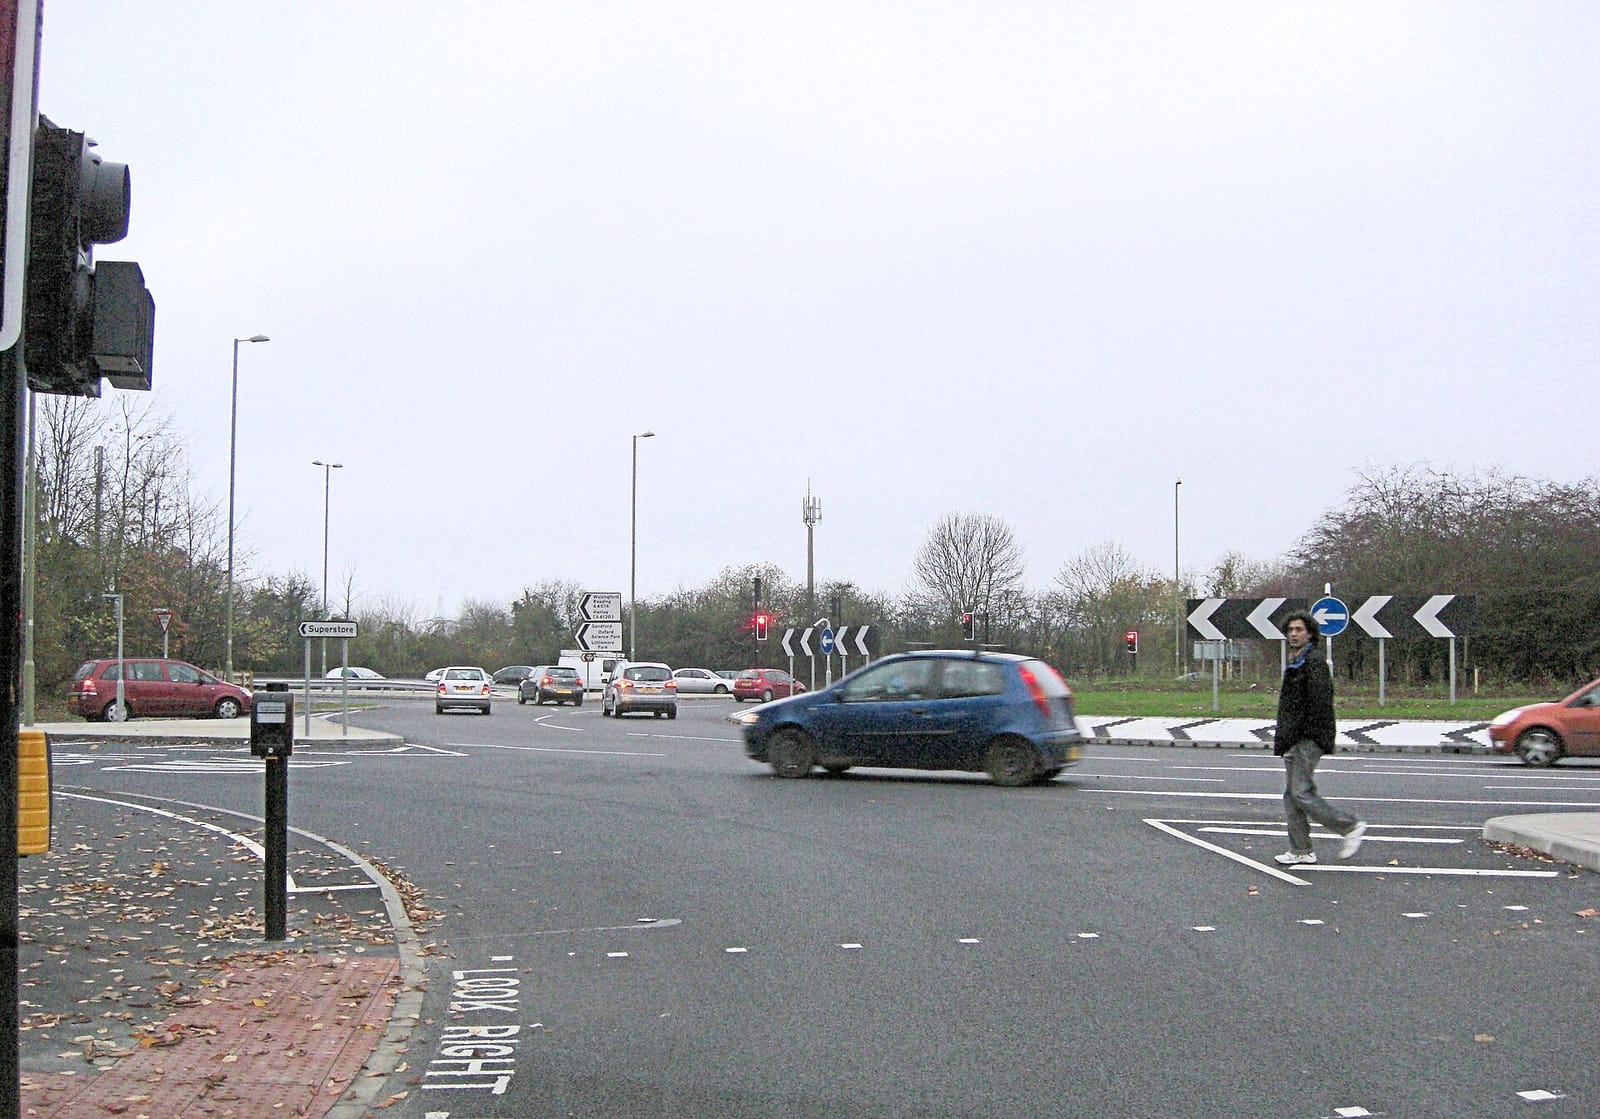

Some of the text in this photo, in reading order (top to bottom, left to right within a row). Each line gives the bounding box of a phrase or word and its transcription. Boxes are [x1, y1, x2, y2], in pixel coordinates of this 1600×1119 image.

[308, 625, 354, 634] Superstore
[421, 968, 521, 1095] LOOK RIGHT
